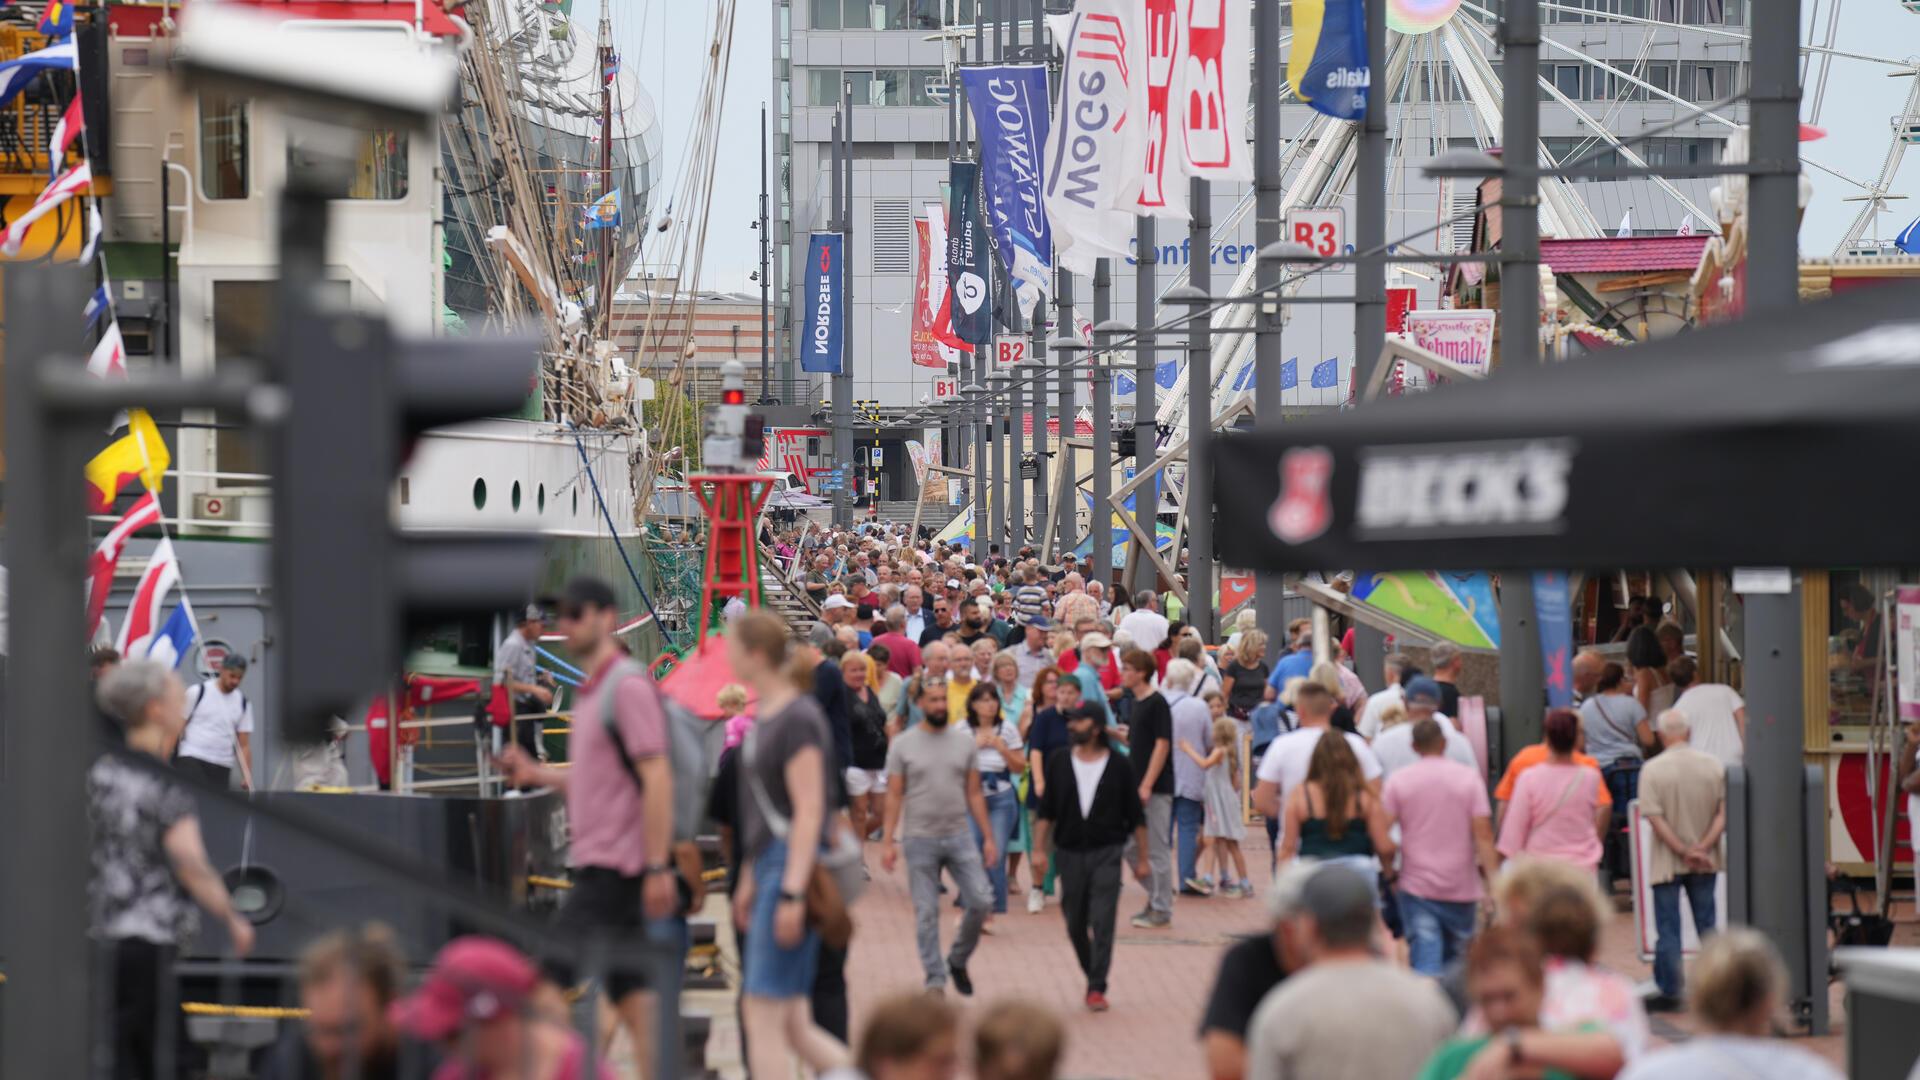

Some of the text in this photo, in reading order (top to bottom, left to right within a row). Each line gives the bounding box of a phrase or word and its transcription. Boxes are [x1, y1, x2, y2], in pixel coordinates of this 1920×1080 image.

[1294, 222, 1337, 257] B3
[999, 342, 1025, 361] B2
[937, 381, 954, 396] B1
